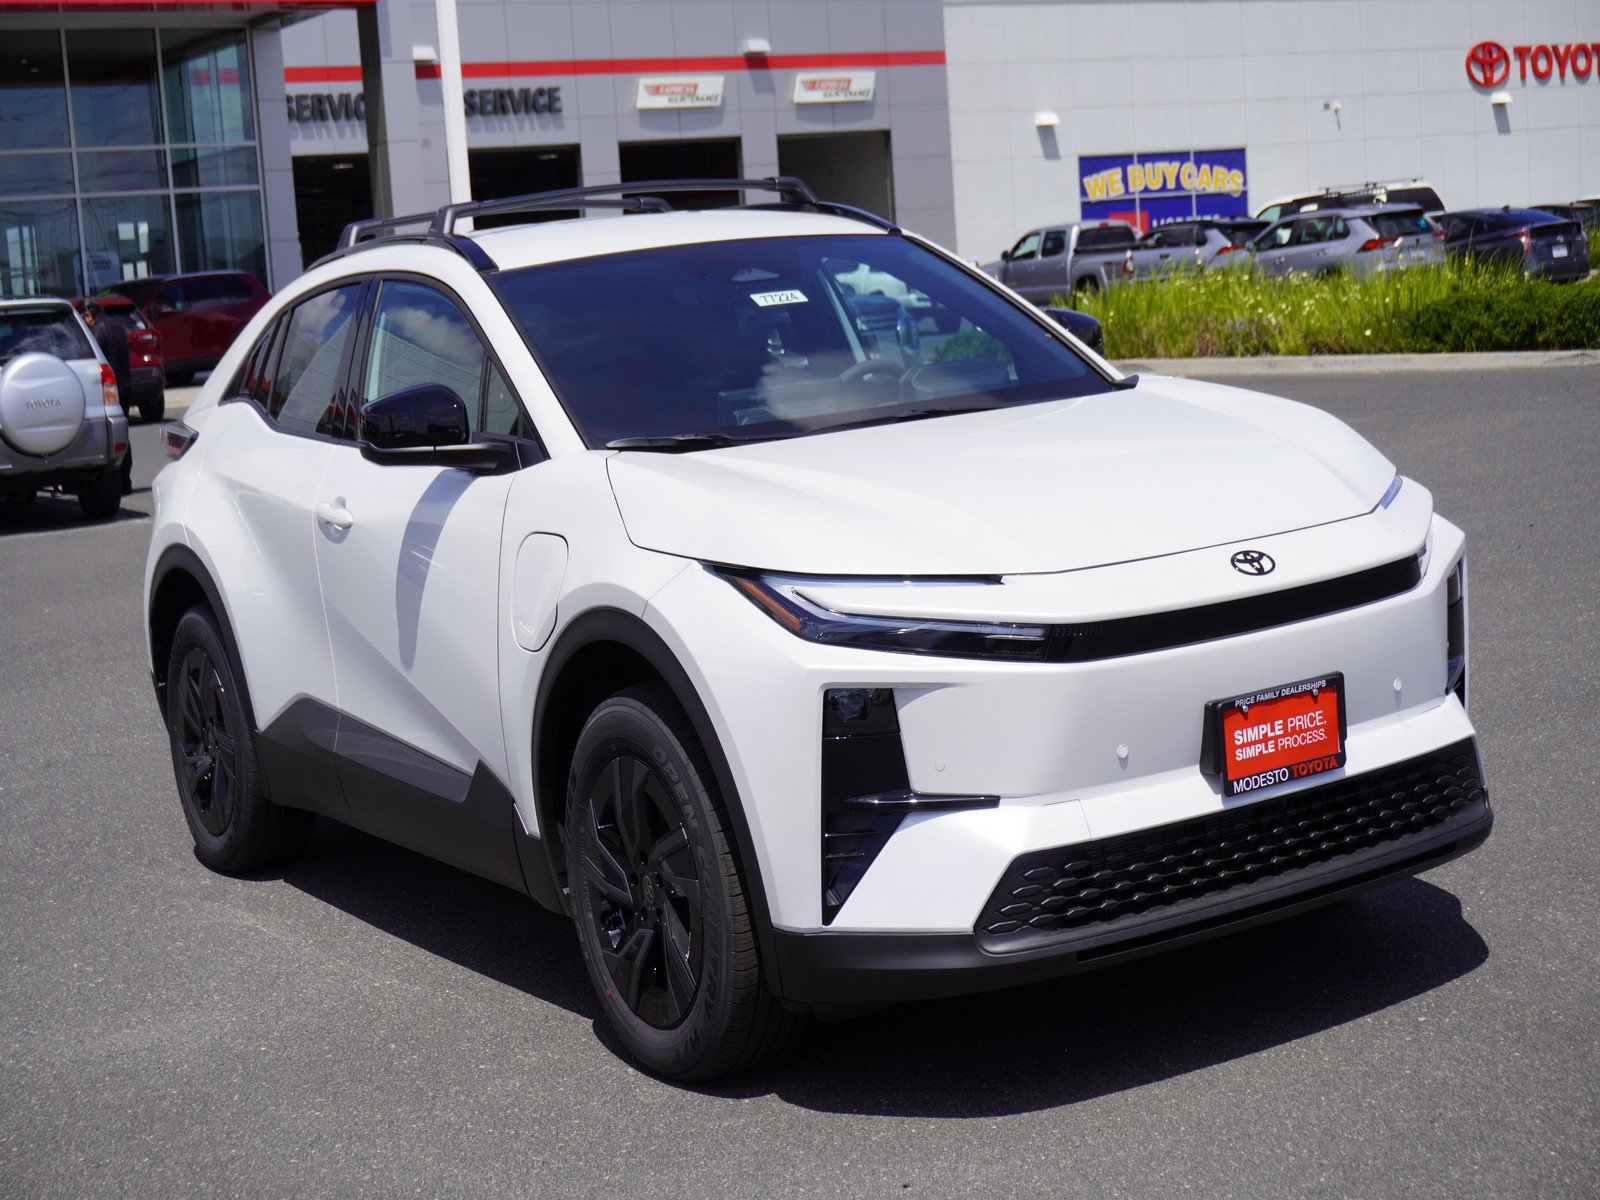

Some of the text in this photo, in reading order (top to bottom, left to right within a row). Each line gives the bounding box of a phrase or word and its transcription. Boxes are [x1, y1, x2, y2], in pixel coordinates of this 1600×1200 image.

[286, 93, 366, 124] SERVIC
[463, 87, 562, 118] SERVICE
[1083, 161, 1244, 202] WE BUY CARS
[759, 292, 799, 304] 77224
[25, 399, 62, 410] TOYOTA
[1235, 680, 1326, 707] PRICE FAMILY DEALERSHIPS
[1234, 710, 1327, 745] SIMPLE PRICE.
[1235, 729, 1327, 761] SIMPLE PROCESS.
[1233, 755, 1338, 794] MODESTO TOYOTA
